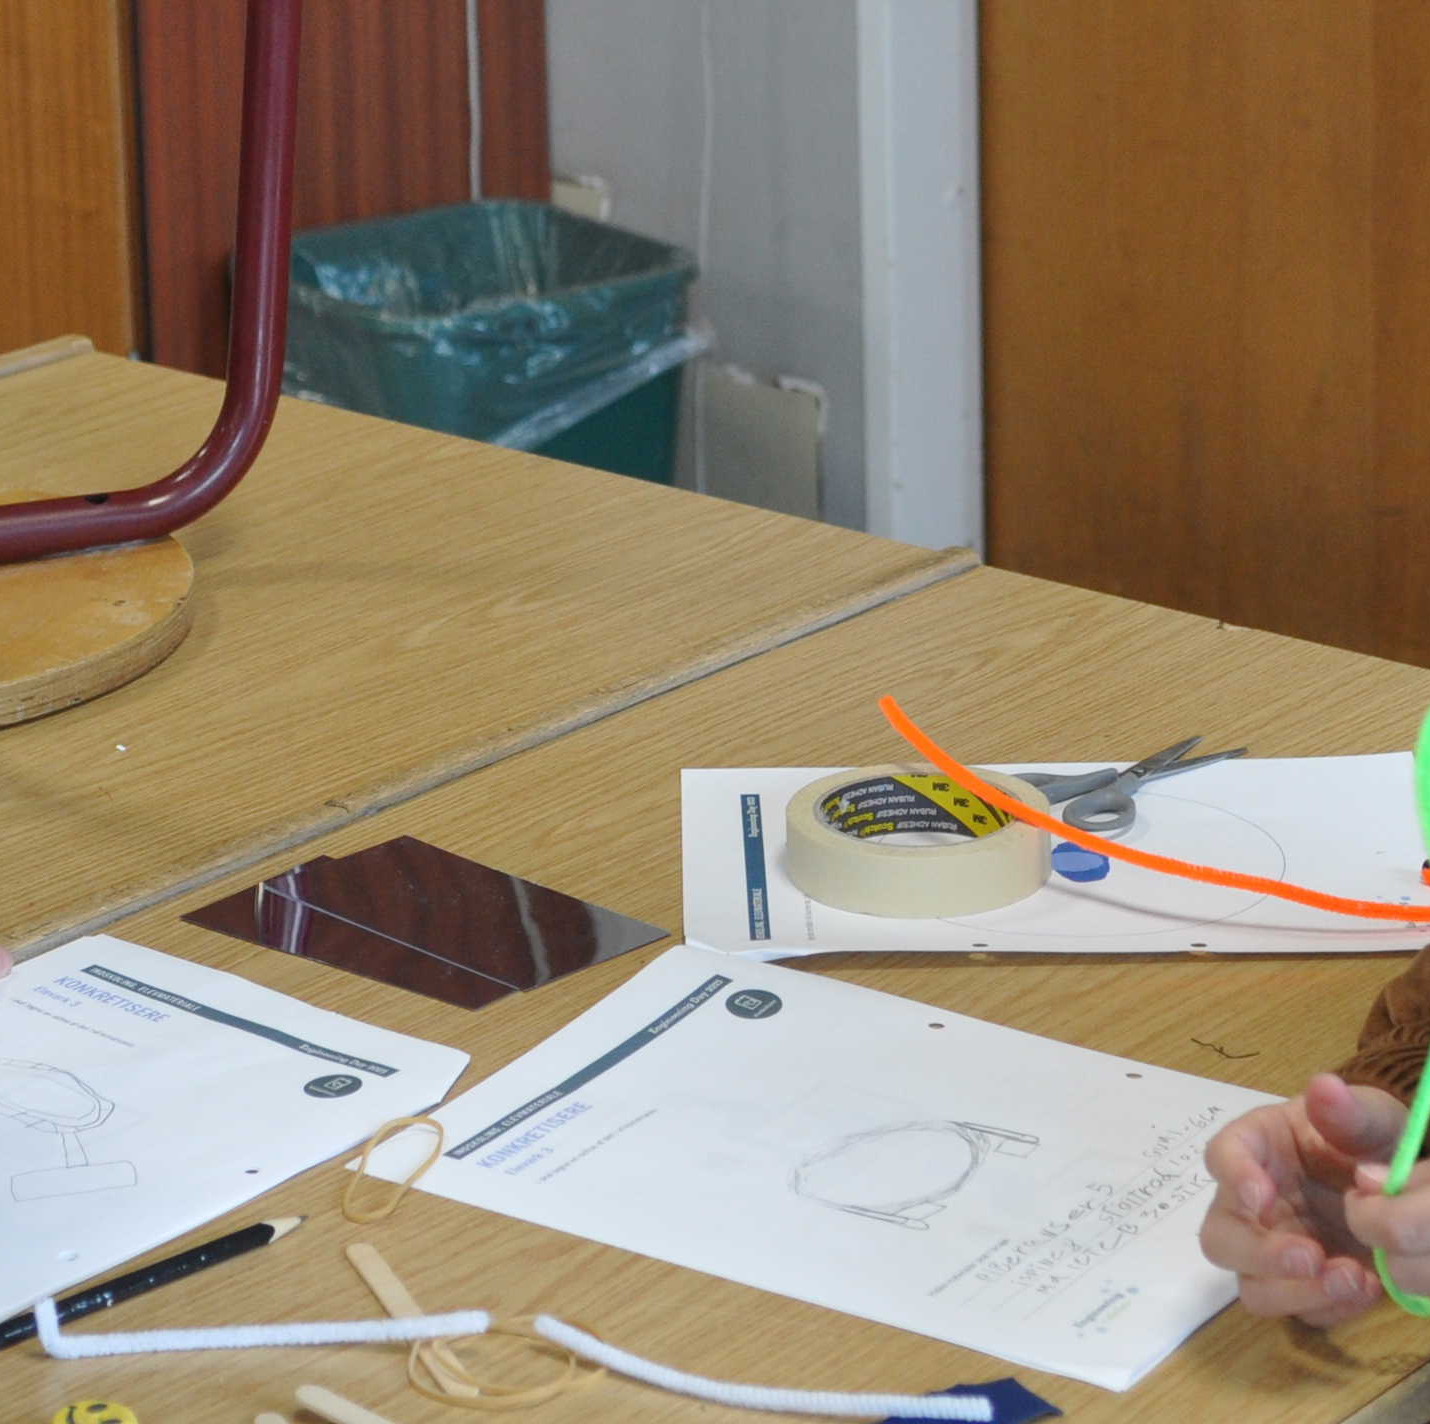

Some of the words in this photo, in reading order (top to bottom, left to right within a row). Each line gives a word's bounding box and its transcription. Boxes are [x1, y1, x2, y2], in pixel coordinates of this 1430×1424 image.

[932, 781, 950, 793] 3M
[953, 796, 971, 808] 3M
[910, 807, 937, 817] RUBAN
[972, 813, 988, 825] 3M
[930, 821, 958, 831] RUBAN
[53, 975, 171, 1024] KONKRETISERE
[476, 1101, 593, 1169] KONKRETISERE
